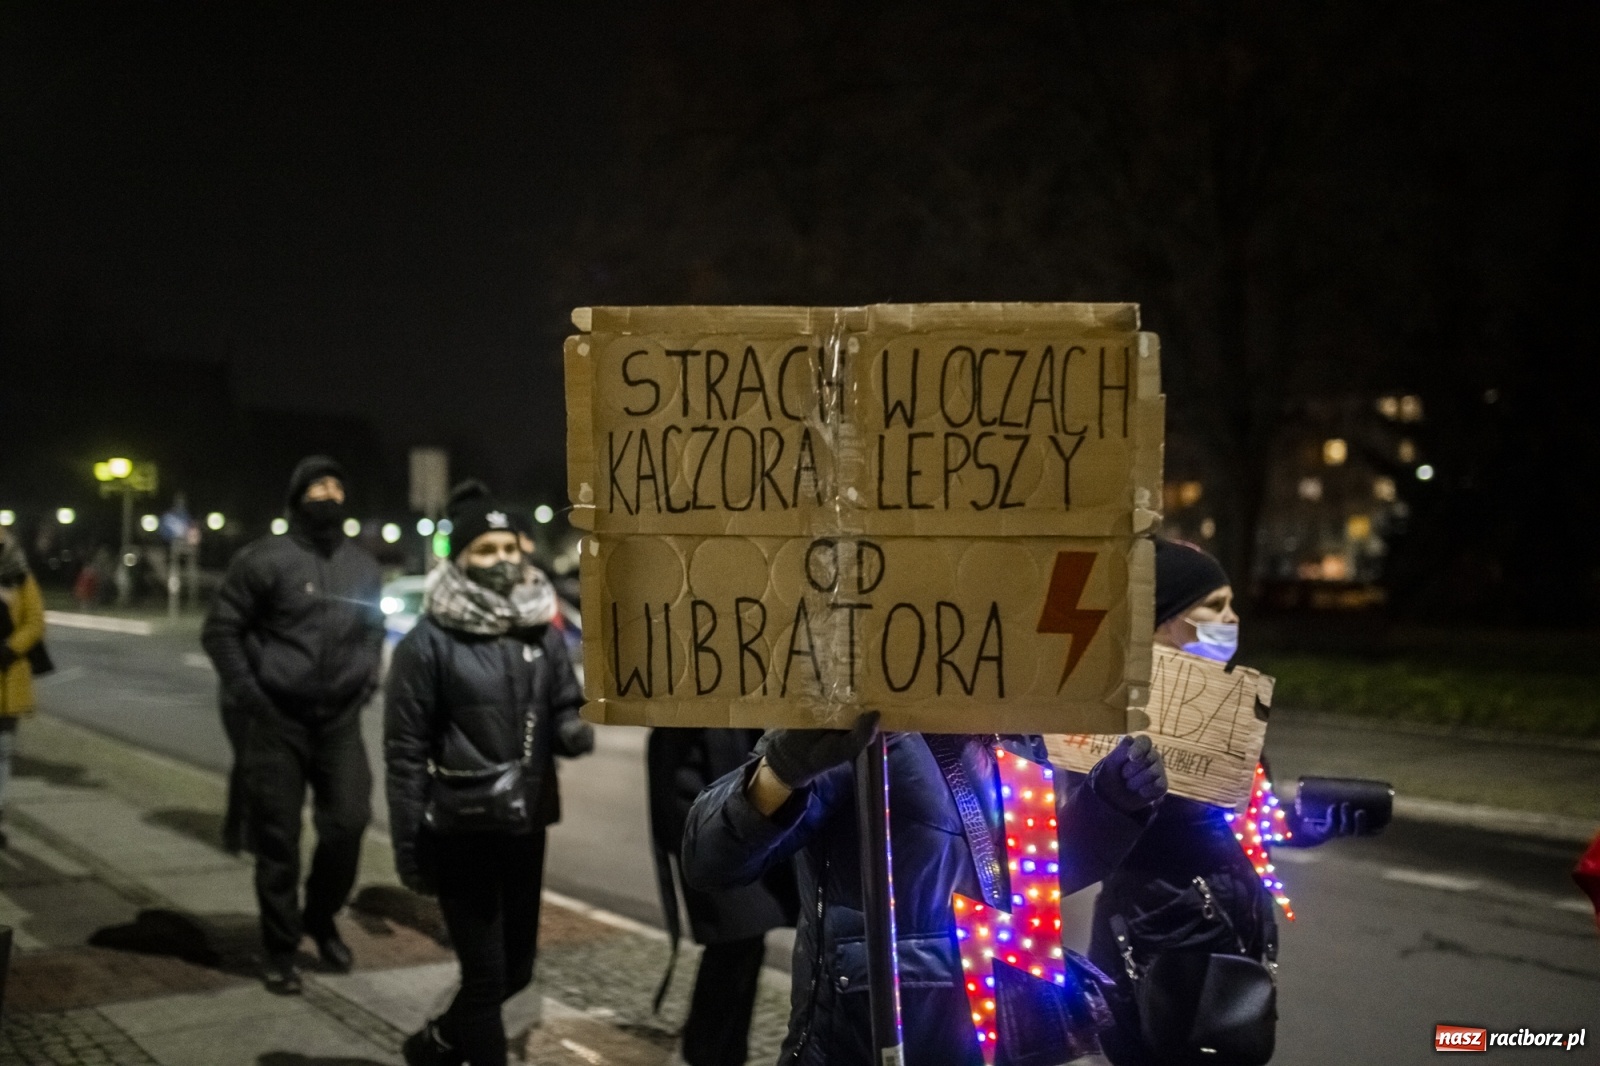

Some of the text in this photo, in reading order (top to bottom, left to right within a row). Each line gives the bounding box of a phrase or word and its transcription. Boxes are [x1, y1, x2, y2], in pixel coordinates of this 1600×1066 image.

[620, 345, 1130, 439] STRACH W OCZACH
[607, 425, 1086, 516] KACZORA LEPSZY
[804, 538, 885, 595] OD
[611, 597, 1005, 699] WIBRATORA
[1152, 653, 1245, 753] ŃBA
